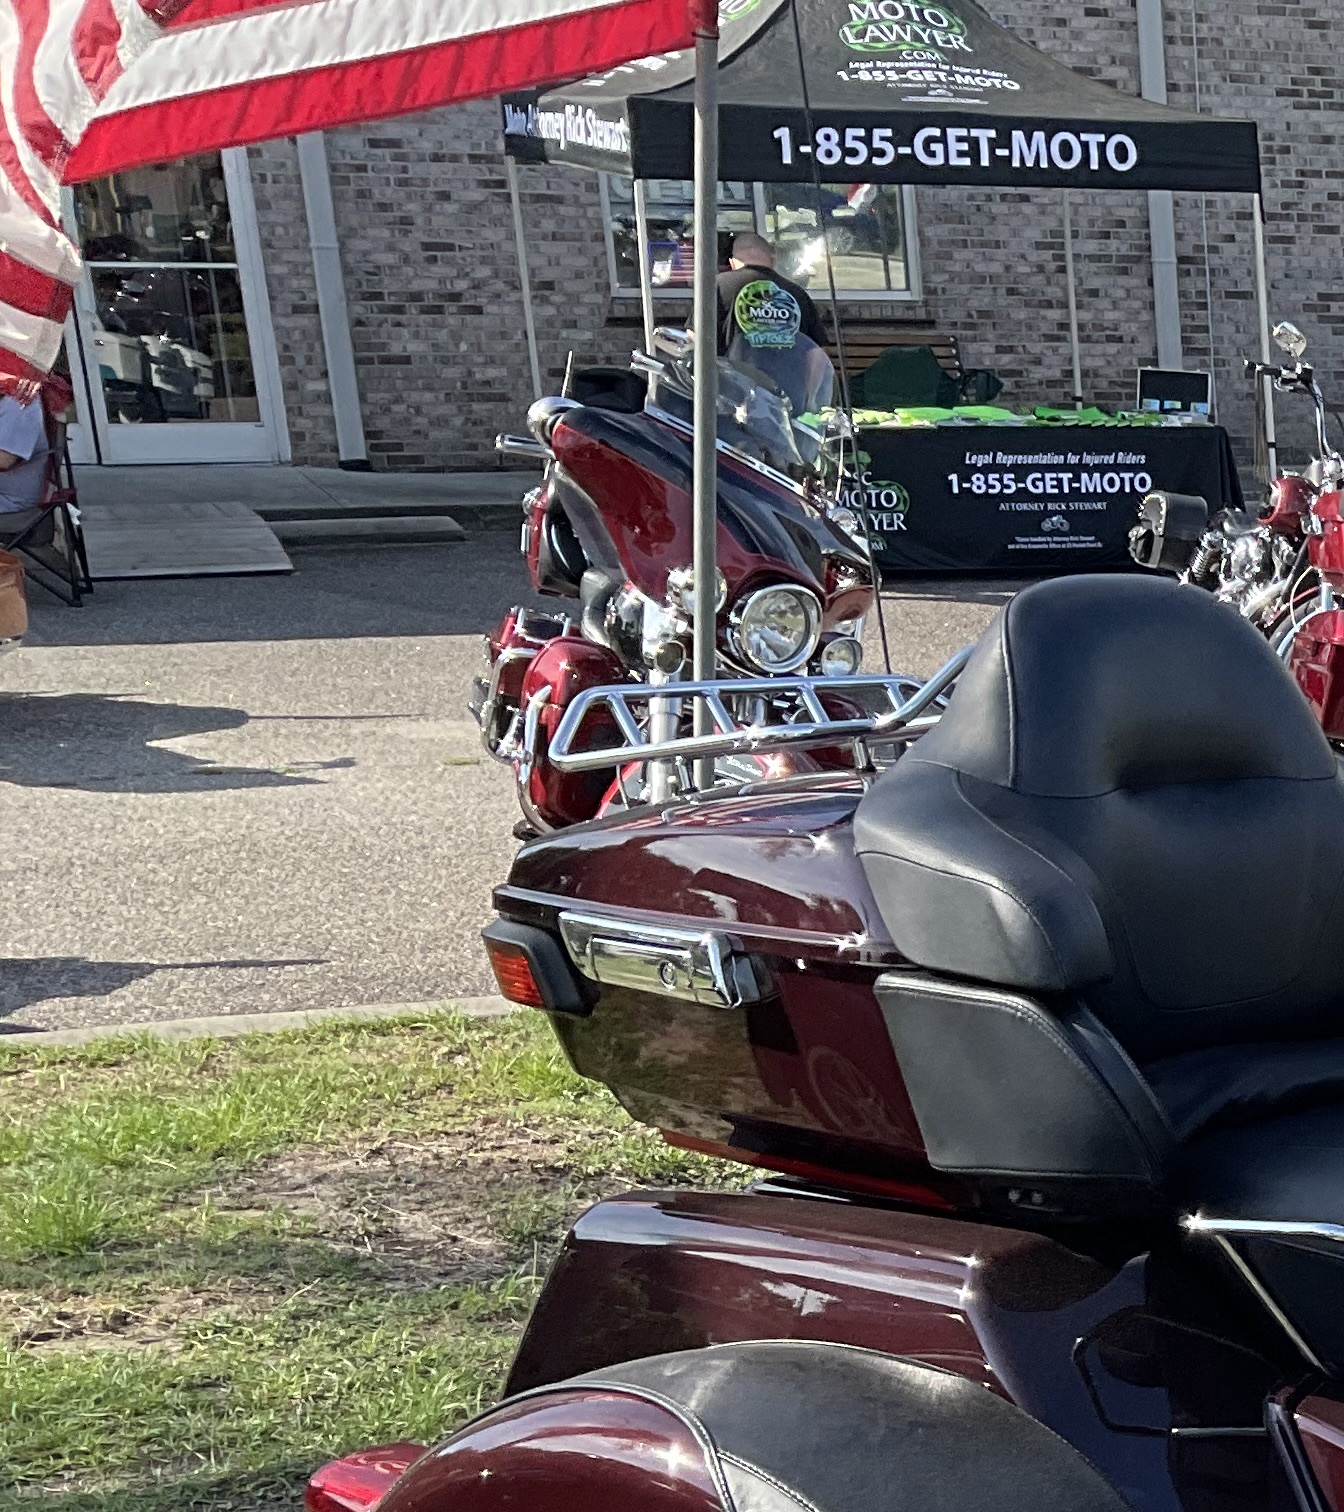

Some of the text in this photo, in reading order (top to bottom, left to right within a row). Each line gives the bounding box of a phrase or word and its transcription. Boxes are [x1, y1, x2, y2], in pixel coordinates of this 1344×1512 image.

[848, 0, 949, 28] MOTO
[842, 24, 973, 52] LAWYER
[898, 50, 941, 62] .COM
[836, 69, 1021, 90] 1-855-GET-MOTO
[773, 127, 1138, 171] 1-855-GET-MOTO
[749, 307, 790, 319] MOTO
[965, 451, 1146, 468] Legal Representation for Injured Riders
[948, 472, 1152, 494] 1-855-GET-MOTO
